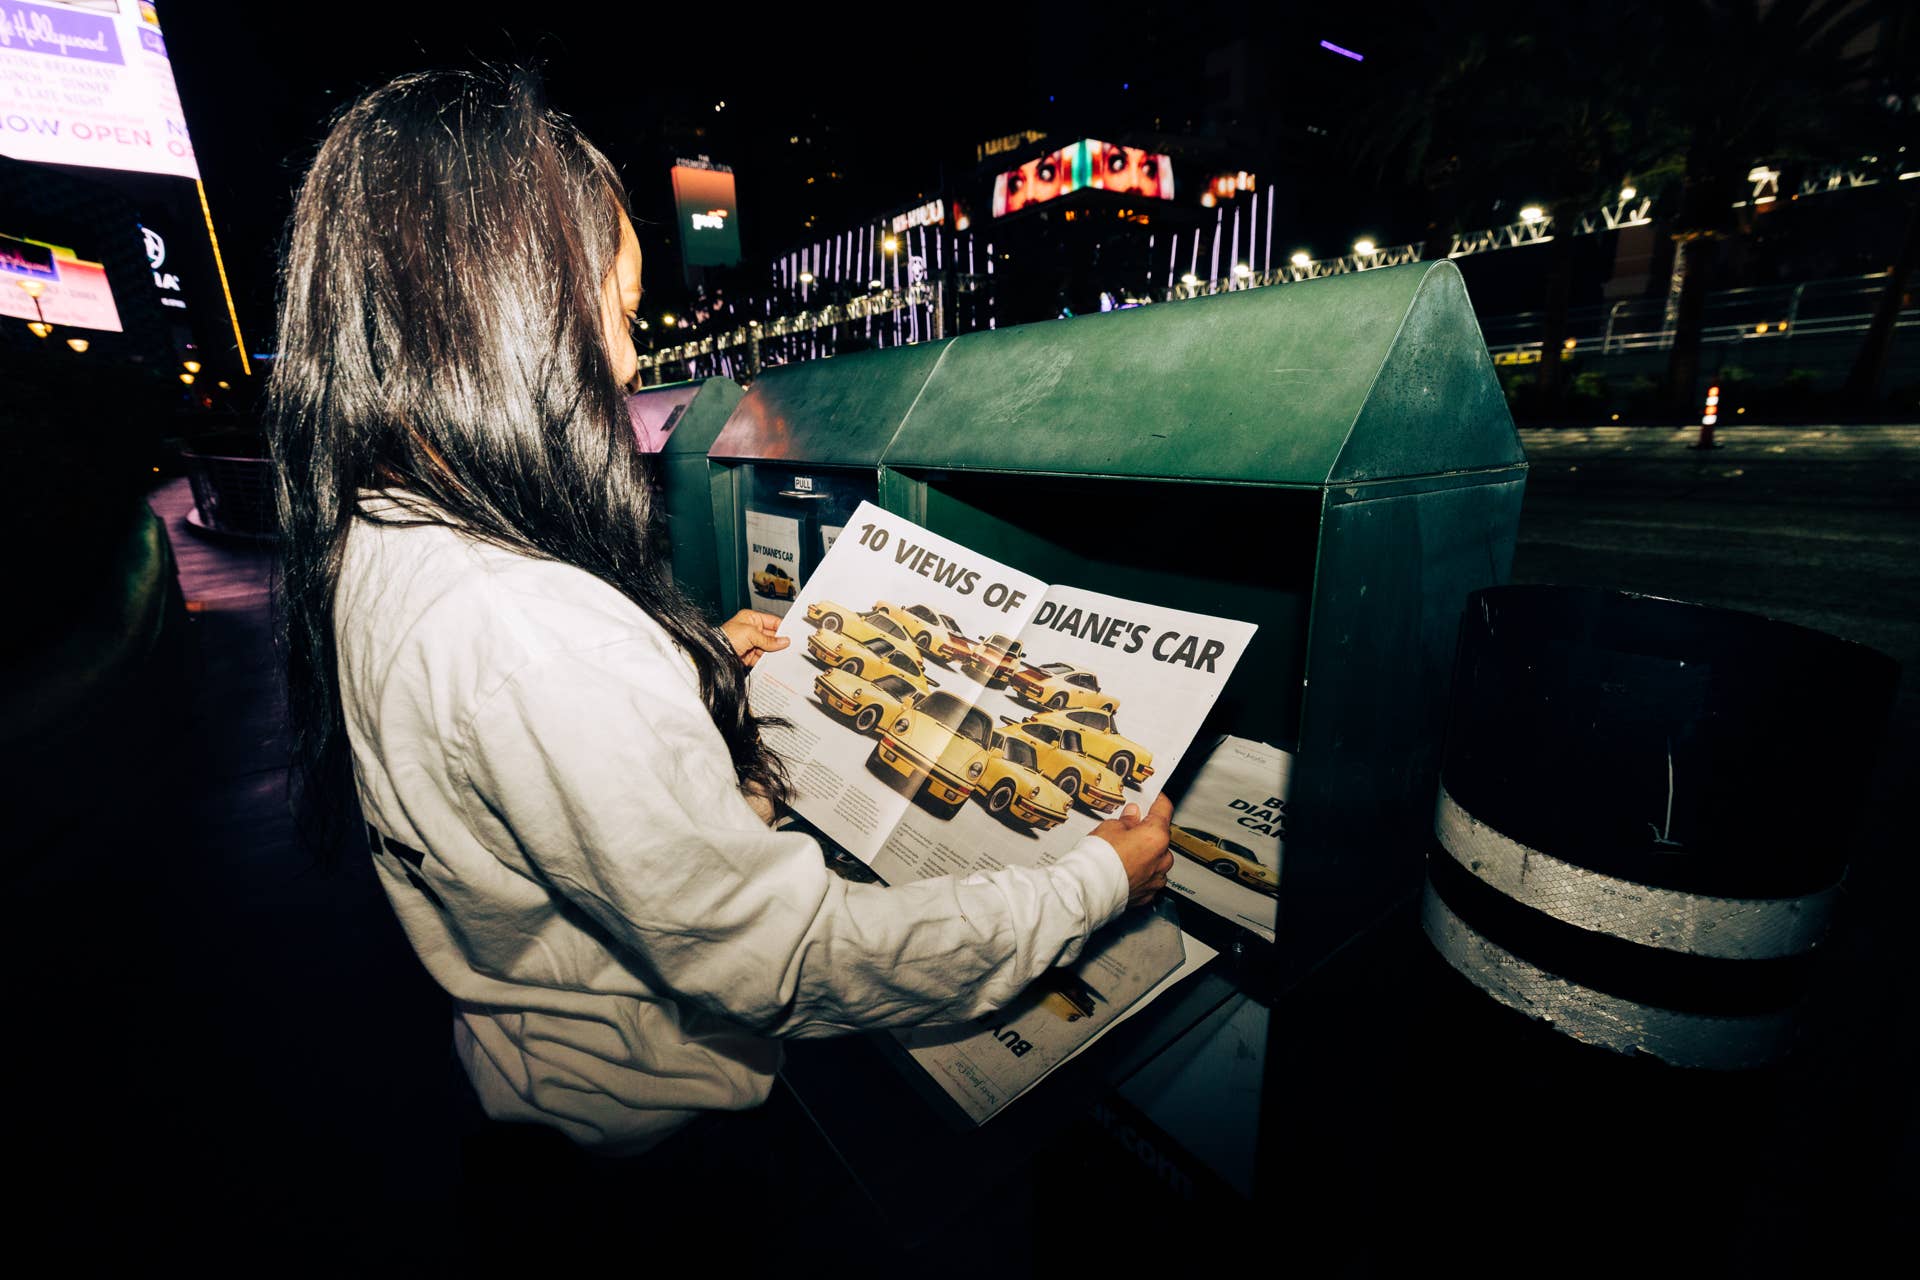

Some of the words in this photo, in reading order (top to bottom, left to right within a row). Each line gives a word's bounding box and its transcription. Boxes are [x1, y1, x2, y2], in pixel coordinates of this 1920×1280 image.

[71, 121, 153, 148] OPEN
[795, 479, 811, 489] PULL
[753, 543, 762, 554] BUY
[782, 551, 794, 563] CAR
[859, 523, 890, 552] 10
[894, 538, 982, 595] VIEWS
[983, 582, 1027, 614] OF
[1032, 600, 1151, 655] DIANE'S
[1152, 631, 1225, 674] CAR
